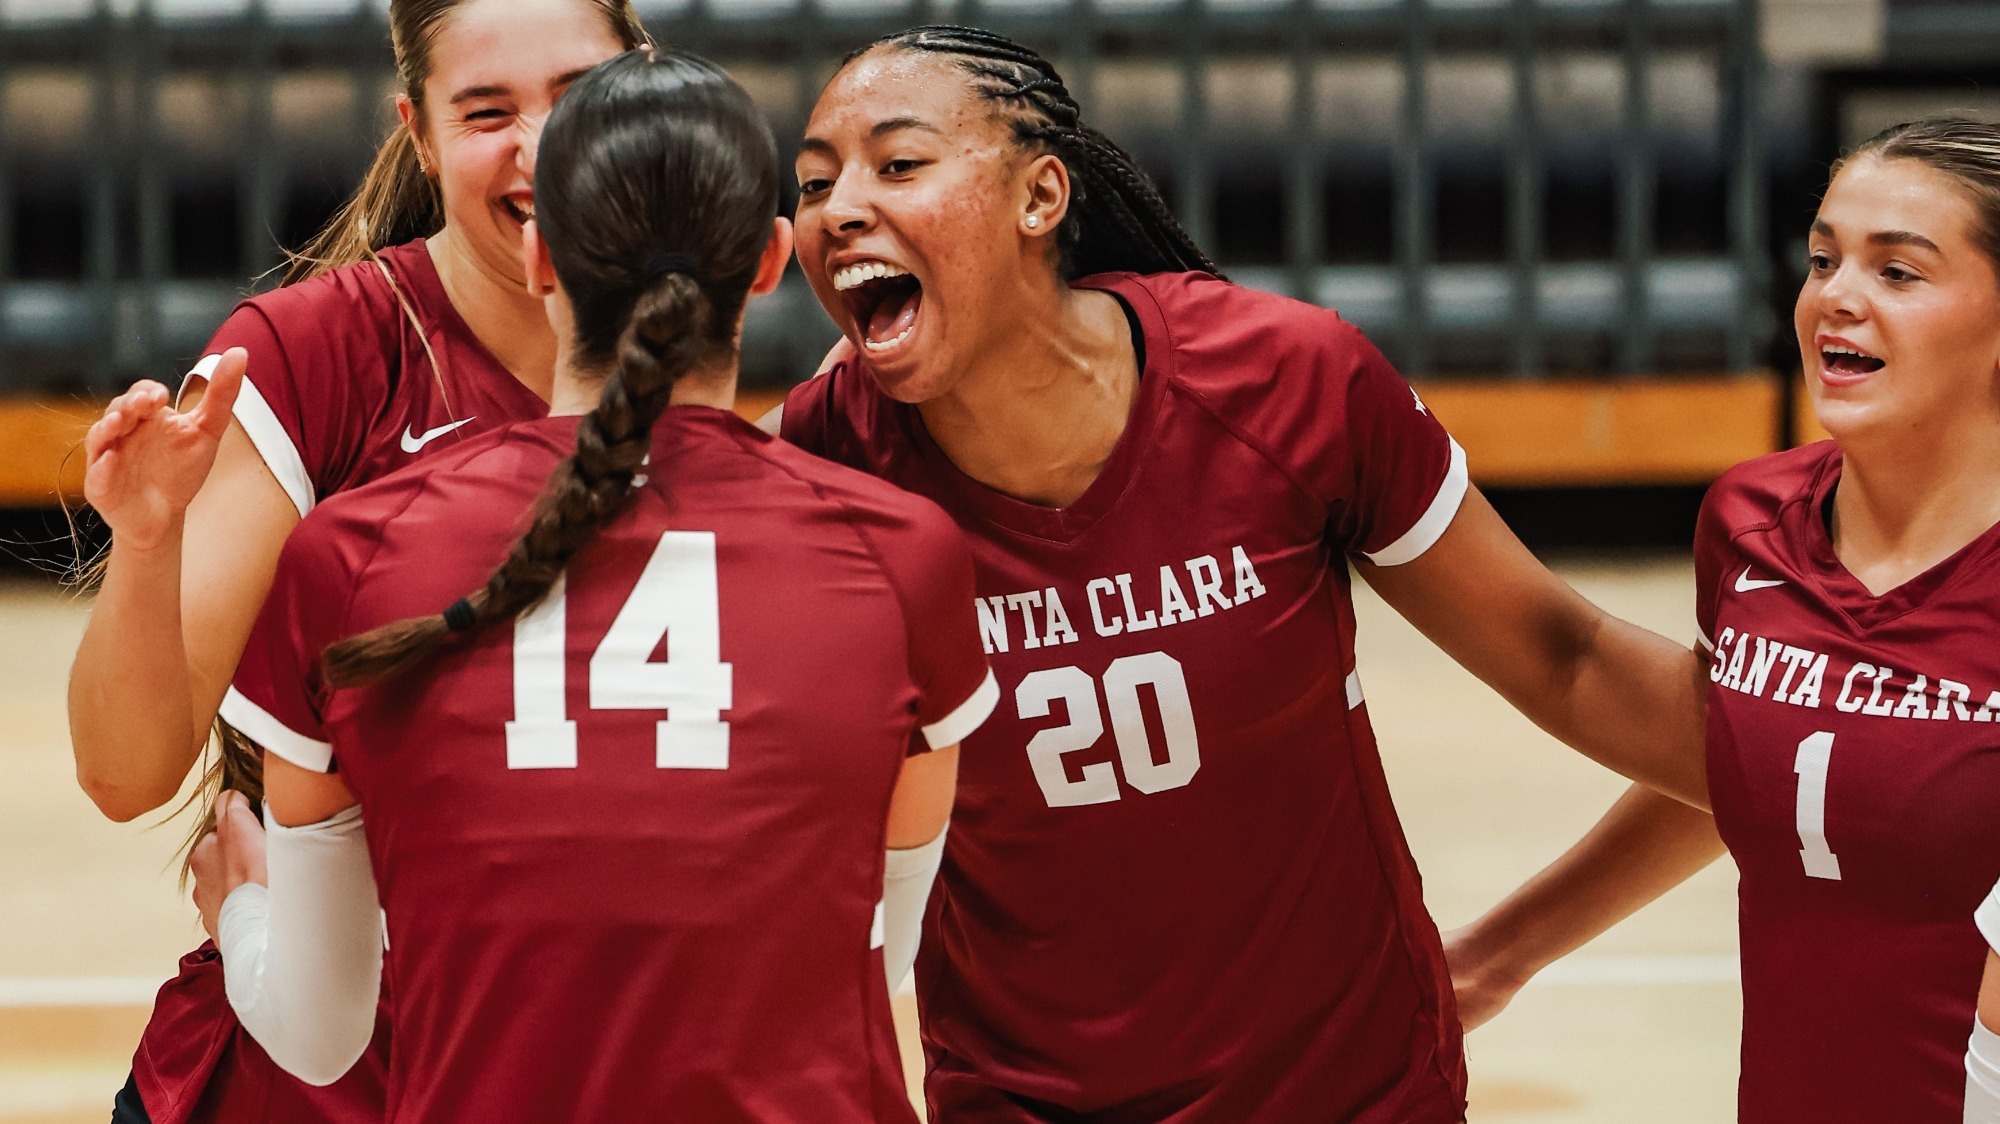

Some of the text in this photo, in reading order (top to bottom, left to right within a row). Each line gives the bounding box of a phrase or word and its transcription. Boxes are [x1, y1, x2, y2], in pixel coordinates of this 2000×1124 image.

[505, 531, 733, 770] 14
[974, 545, 1267, 654] NTA CLARA
[1710, 626, 2000, 722] SANTA CLARA
[1015, 651, 1201, 807] 20
[1794, 731, 1842, 880] 1
